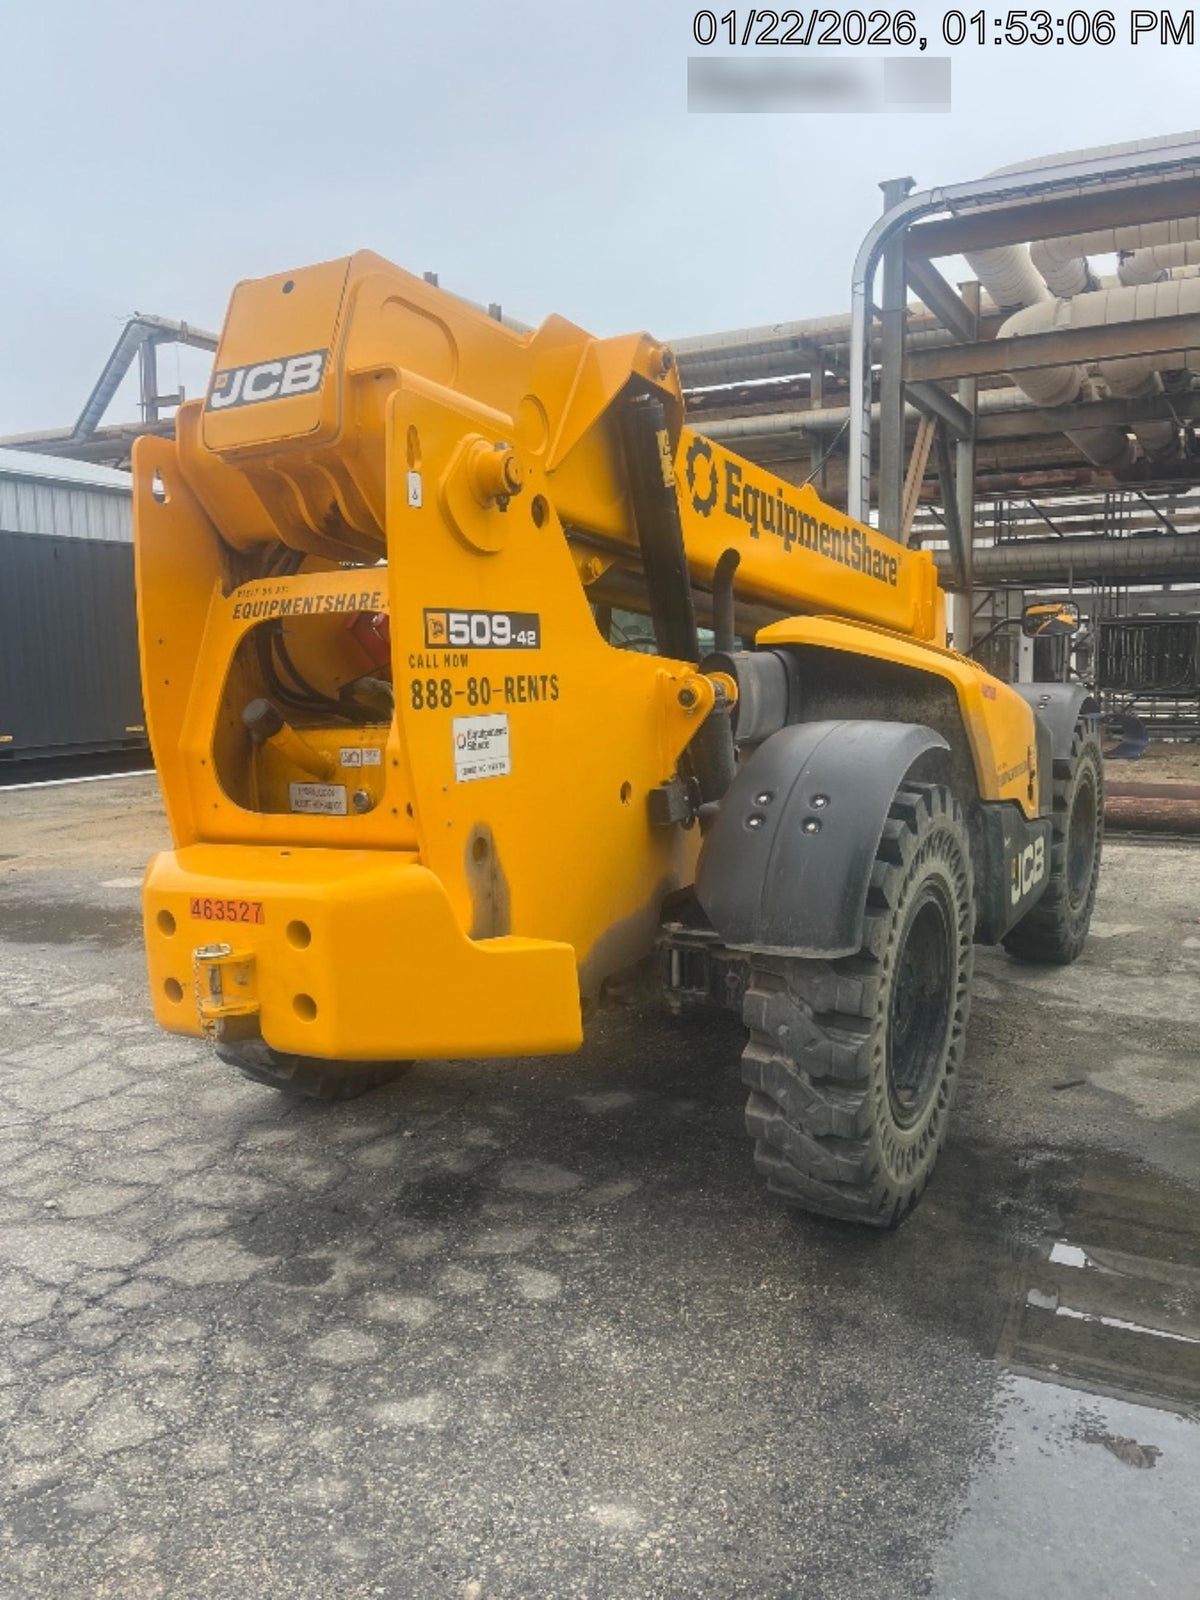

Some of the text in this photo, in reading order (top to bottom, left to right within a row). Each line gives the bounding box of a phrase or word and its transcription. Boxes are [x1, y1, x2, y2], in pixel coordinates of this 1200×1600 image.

[210, 354, 324, 409] JCB
[724, 459, 898, 587] EquipmentShare
[232, 592, 390, 619] EQUIPMENTSHARE.
[408, 654, 469, 668] CALL NOW
[411, 674, 559, 710] 888-80-RENTS
[1011, 836, 1044, 905] JCB
[191, 899, 263, 924] 463527
